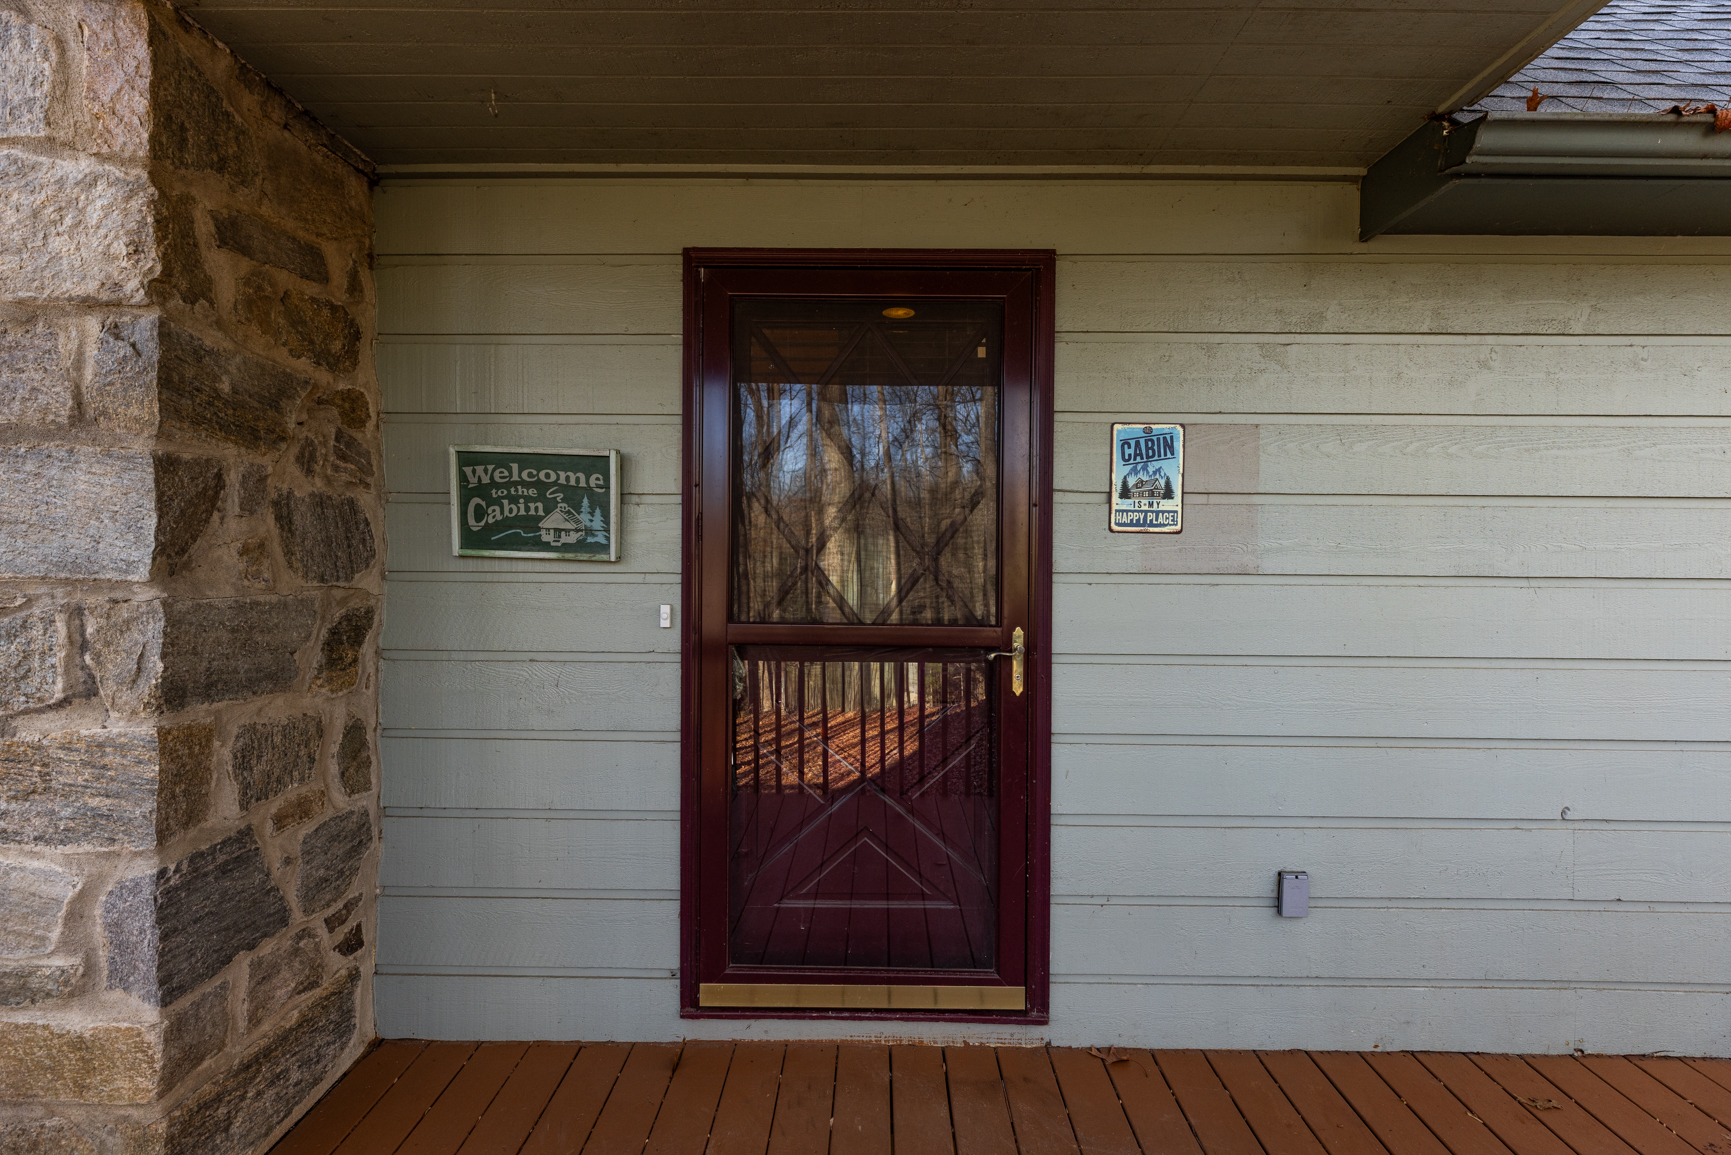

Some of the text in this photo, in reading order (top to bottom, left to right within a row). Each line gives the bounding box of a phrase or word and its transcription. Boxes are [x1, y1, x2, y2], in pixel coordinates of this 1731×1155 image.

[1120, 435, 1175, 463] CABIN
[461, 463, 606, 493] Welcome
[490, 485, 538, 498] to the
[467, 497, 545, 532] Cabin
[1116, 511, 1177, 525] HAPPY PLACE!
